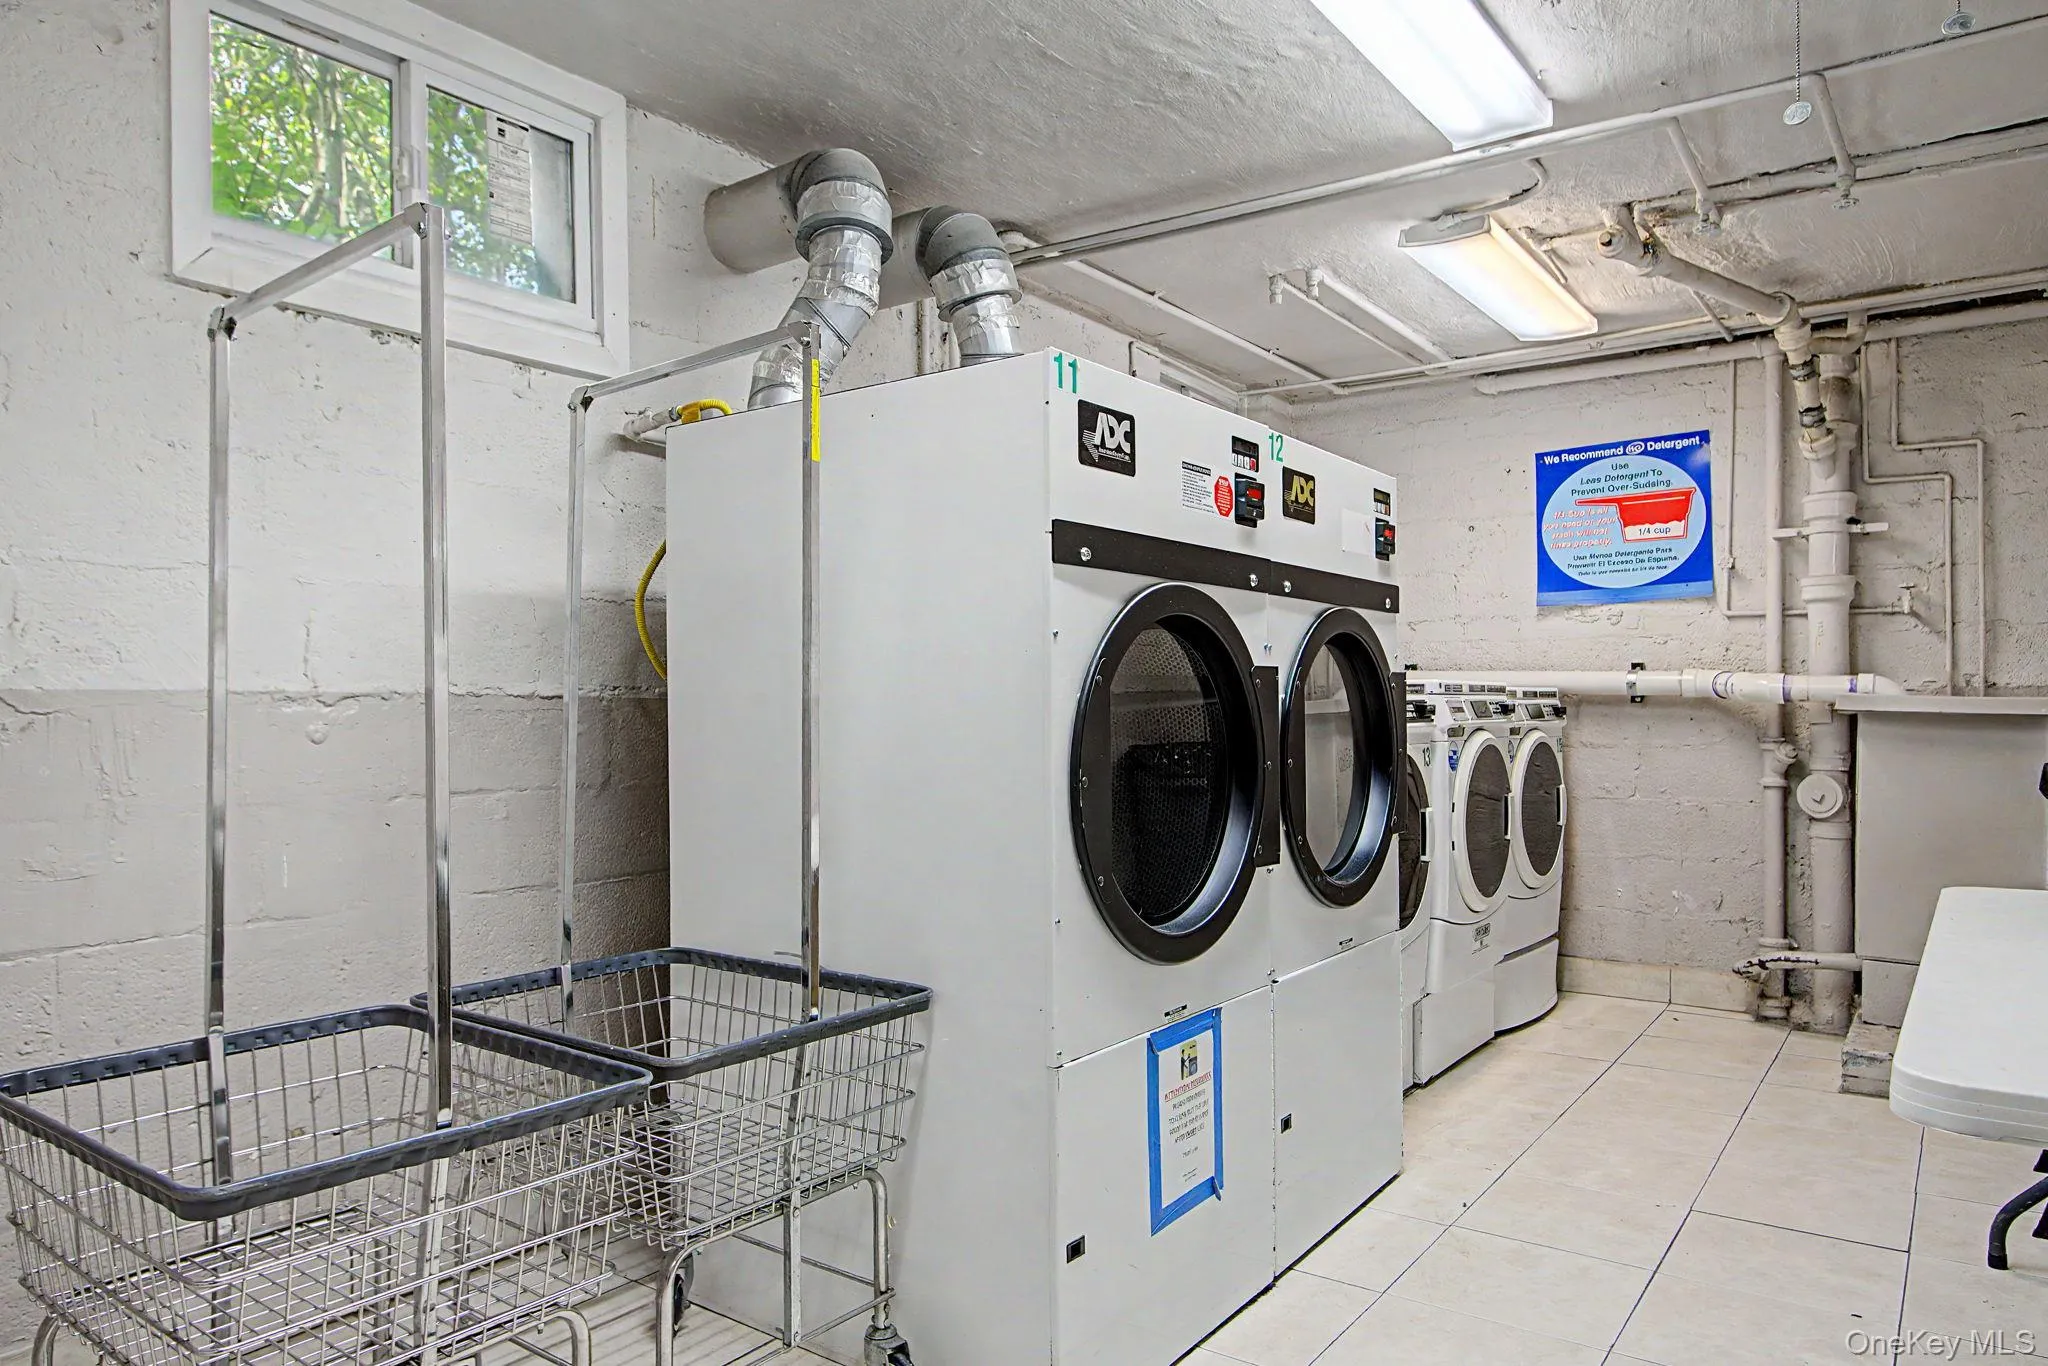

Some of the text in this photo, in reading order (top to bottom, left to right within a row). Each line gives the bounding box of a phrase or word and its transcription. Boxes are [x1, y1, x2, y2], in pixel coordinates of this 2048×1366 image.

[1054, 352, 1077, 394] 11
[1094, 411, 1131, 454] ADC
[1269, 432, 1284, 463] 12
[1544, 455, 1560, 465] We
[1561, 446, 1624, 462] Recommend
[1647, 436, 1700, 451] Detergent
[1580, 469, 1663, 485] Less Detergent To
[1611, 462, 1629, 471] Use
[1291, 475, 1315, 507] ADC
[1571, 486, 1605, 497] Prevent
[1639, 526, 1671, 536] 1/4 cup
[1422, 746, 1431, 767] 13
